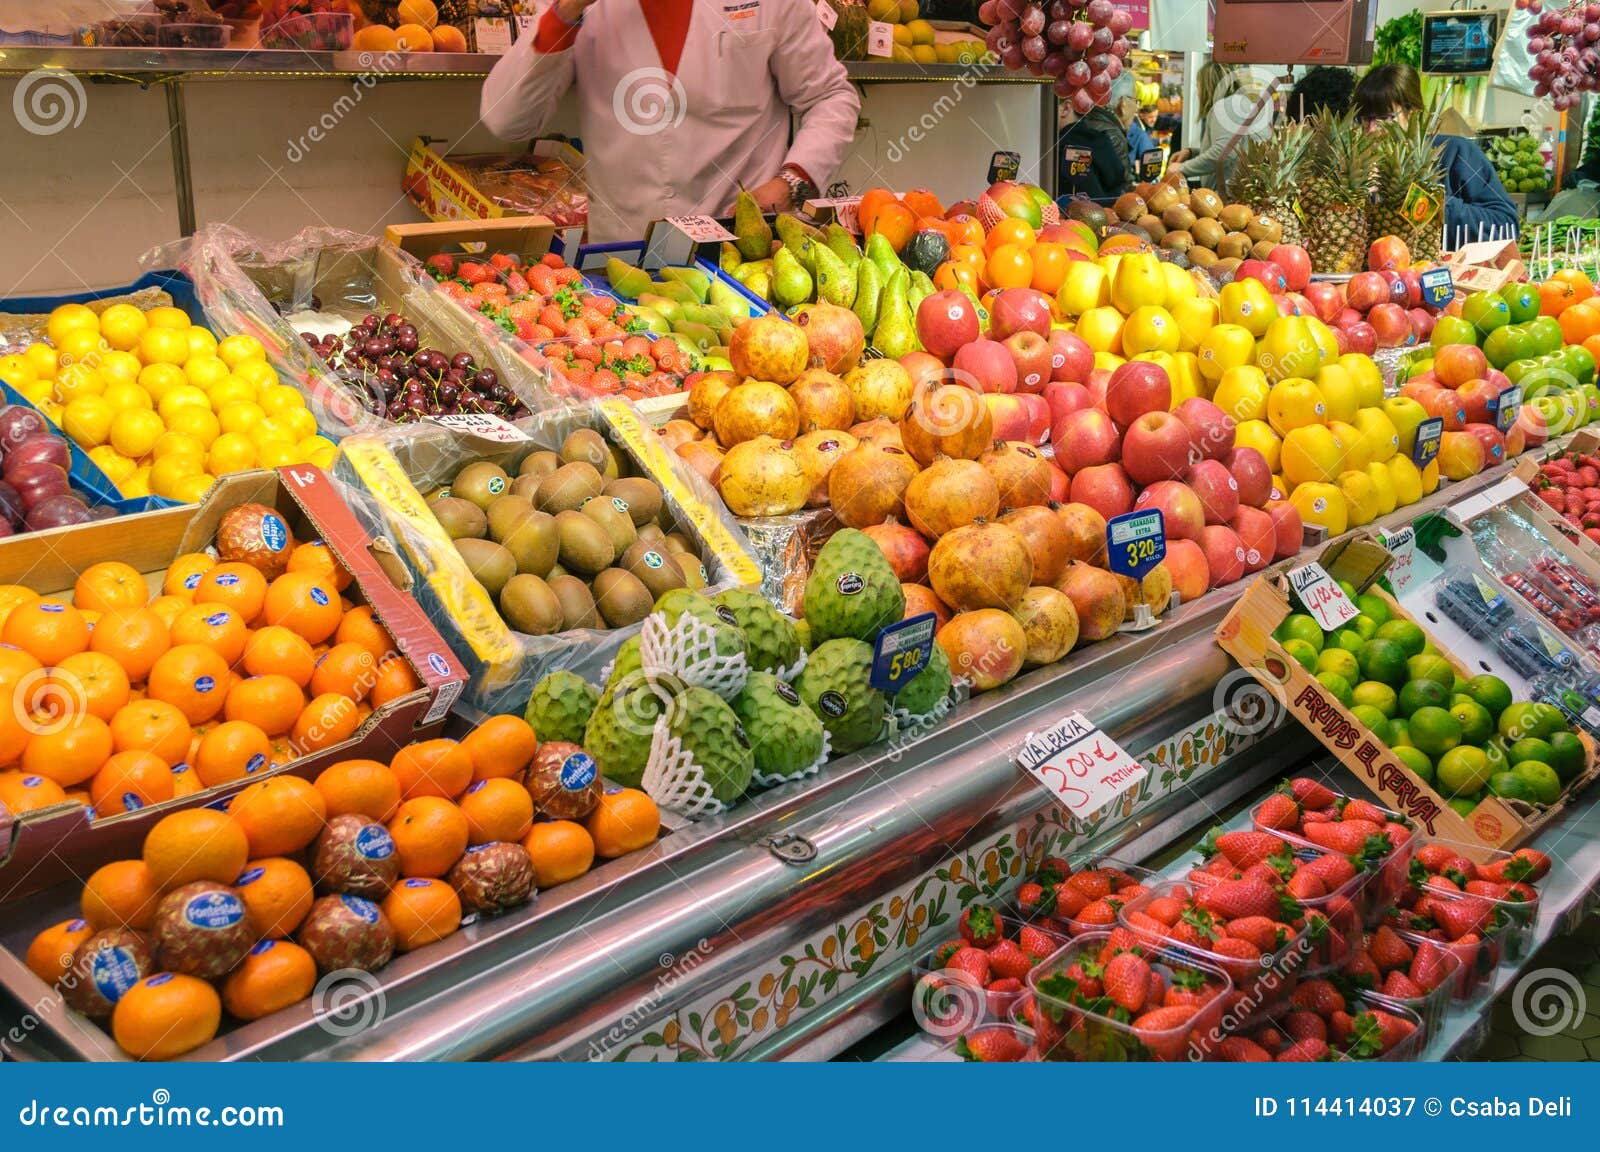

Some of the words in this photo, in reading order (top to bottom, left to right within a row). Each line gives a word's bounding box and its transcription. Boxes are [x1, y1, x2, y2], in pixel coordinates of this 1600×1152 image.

[423, 154, 489, 220] FUENTES
[1129, 516, 1156, 528] GRANADAS
[1135, 527, 1151, 536] EXTRA
[1294, 685, 1361, 749] FRUTAS
[1354, 741, 1381, 778] EL
[1378, 763, 1442, 836] CERVAL
[188, 903, 242, 920] Fontestad
